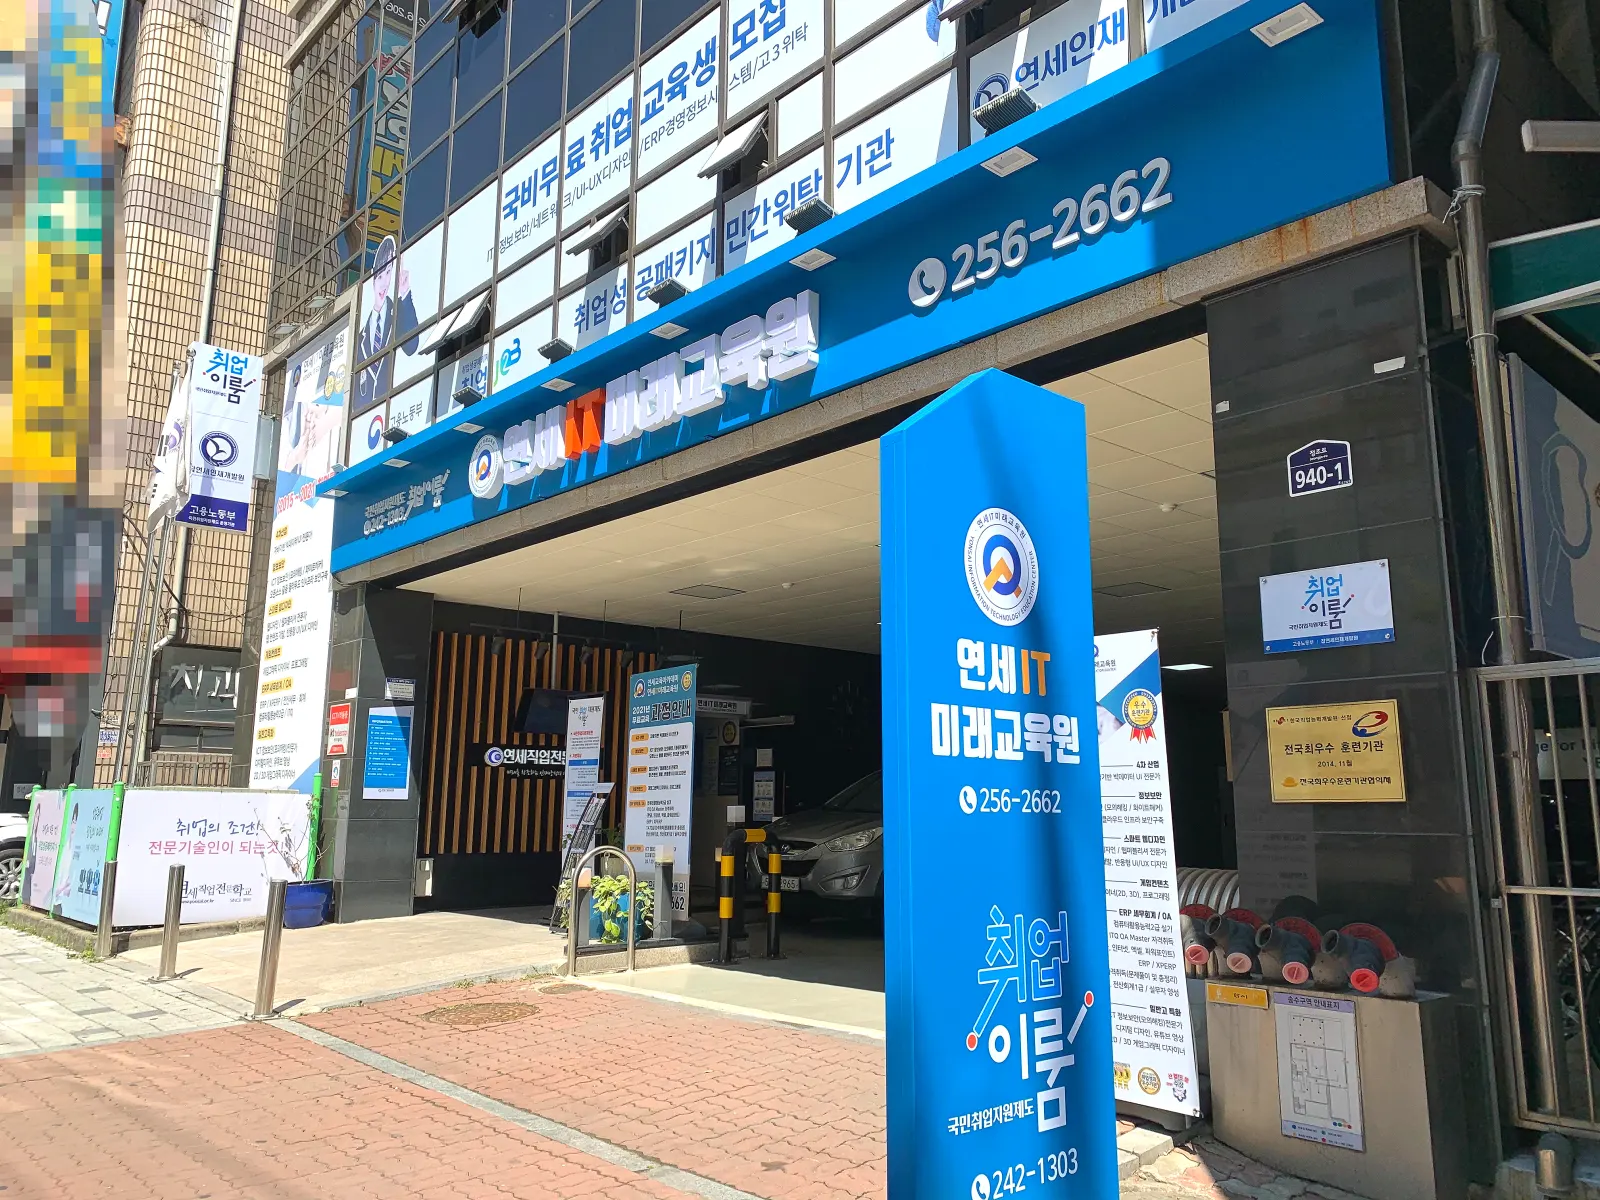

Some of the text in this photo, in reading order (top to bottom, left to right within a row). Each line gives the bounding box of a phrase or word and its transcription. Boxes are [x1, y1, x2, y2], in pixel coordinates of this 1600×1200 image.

[1014, 7, 1126, 92] 연세인재
[502, 0, 787, 221] 국비무료 취업 교육생 모집
[573, 128, 895, 335] 취업성공패키지 민간위탁 기관
[951, 157, 1174, 293] 256-2662
[204, 348, 249, 376] 취업
[210, 373, 246, 405] 이룸
[1295, 461, 1344, 490] 940-1
[189, 504, 236, 521] 고용노동부
[1304, 573, 1344, 606] 취업
[1308, 598, 1347, 631] 이룸
[956, 637, 1052, 697] 연세IT
[930, 702, 1081, 766] 미래교육원
[1284, 740, 1385, 756] 전국최우수 훈련기관
[1147, 760, 1160, 769] 산업
[979, 787, 1062, 815] 256-2662
[1138, 791, 1163, 800] 정보보안
[176, 818, 260, 838] 취업의 조건!
[1123, 834, 1142, 844] 스마트
[148, 840, 234, 855] 전문기술인이
[1118, 908, 1132, 917] ERP
[1129, 932, 1151, 943] Master
[974, 904, 1070, 1037] 취업
[1287, 995, 1341, 1011] 송수구역 안내표지
[988, 1007, 1076, 1134] 이룸
[947, 1097, 1036, 1137] 국민취업지원제도
[991, 1147, 1080, 1200] 242-1303
